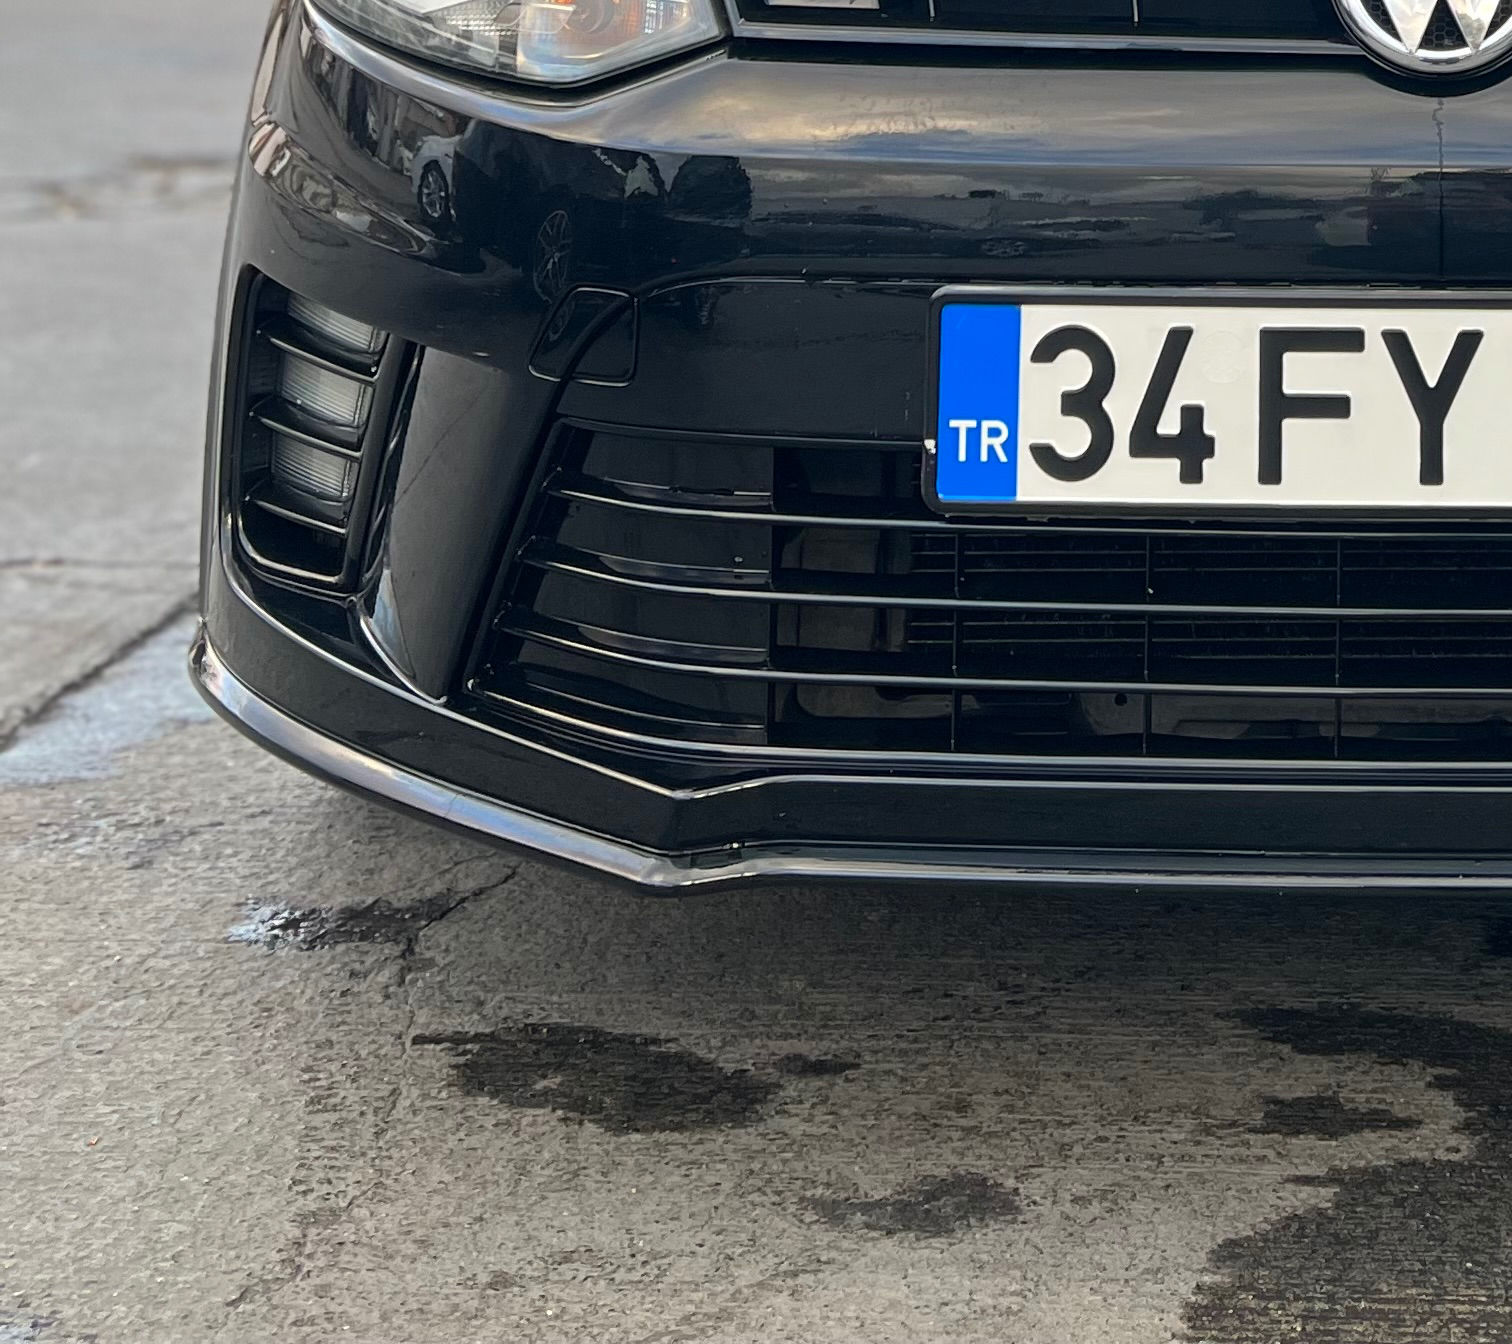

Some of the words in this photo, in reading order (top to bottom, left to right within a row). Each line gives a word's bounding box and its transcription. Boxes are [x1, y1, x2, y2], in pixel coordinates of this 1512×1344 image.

[949, 419, 1009, 463] TR
[1029, 324, 1216, 485] 34
[1257, 327, 1484, 486] FY
